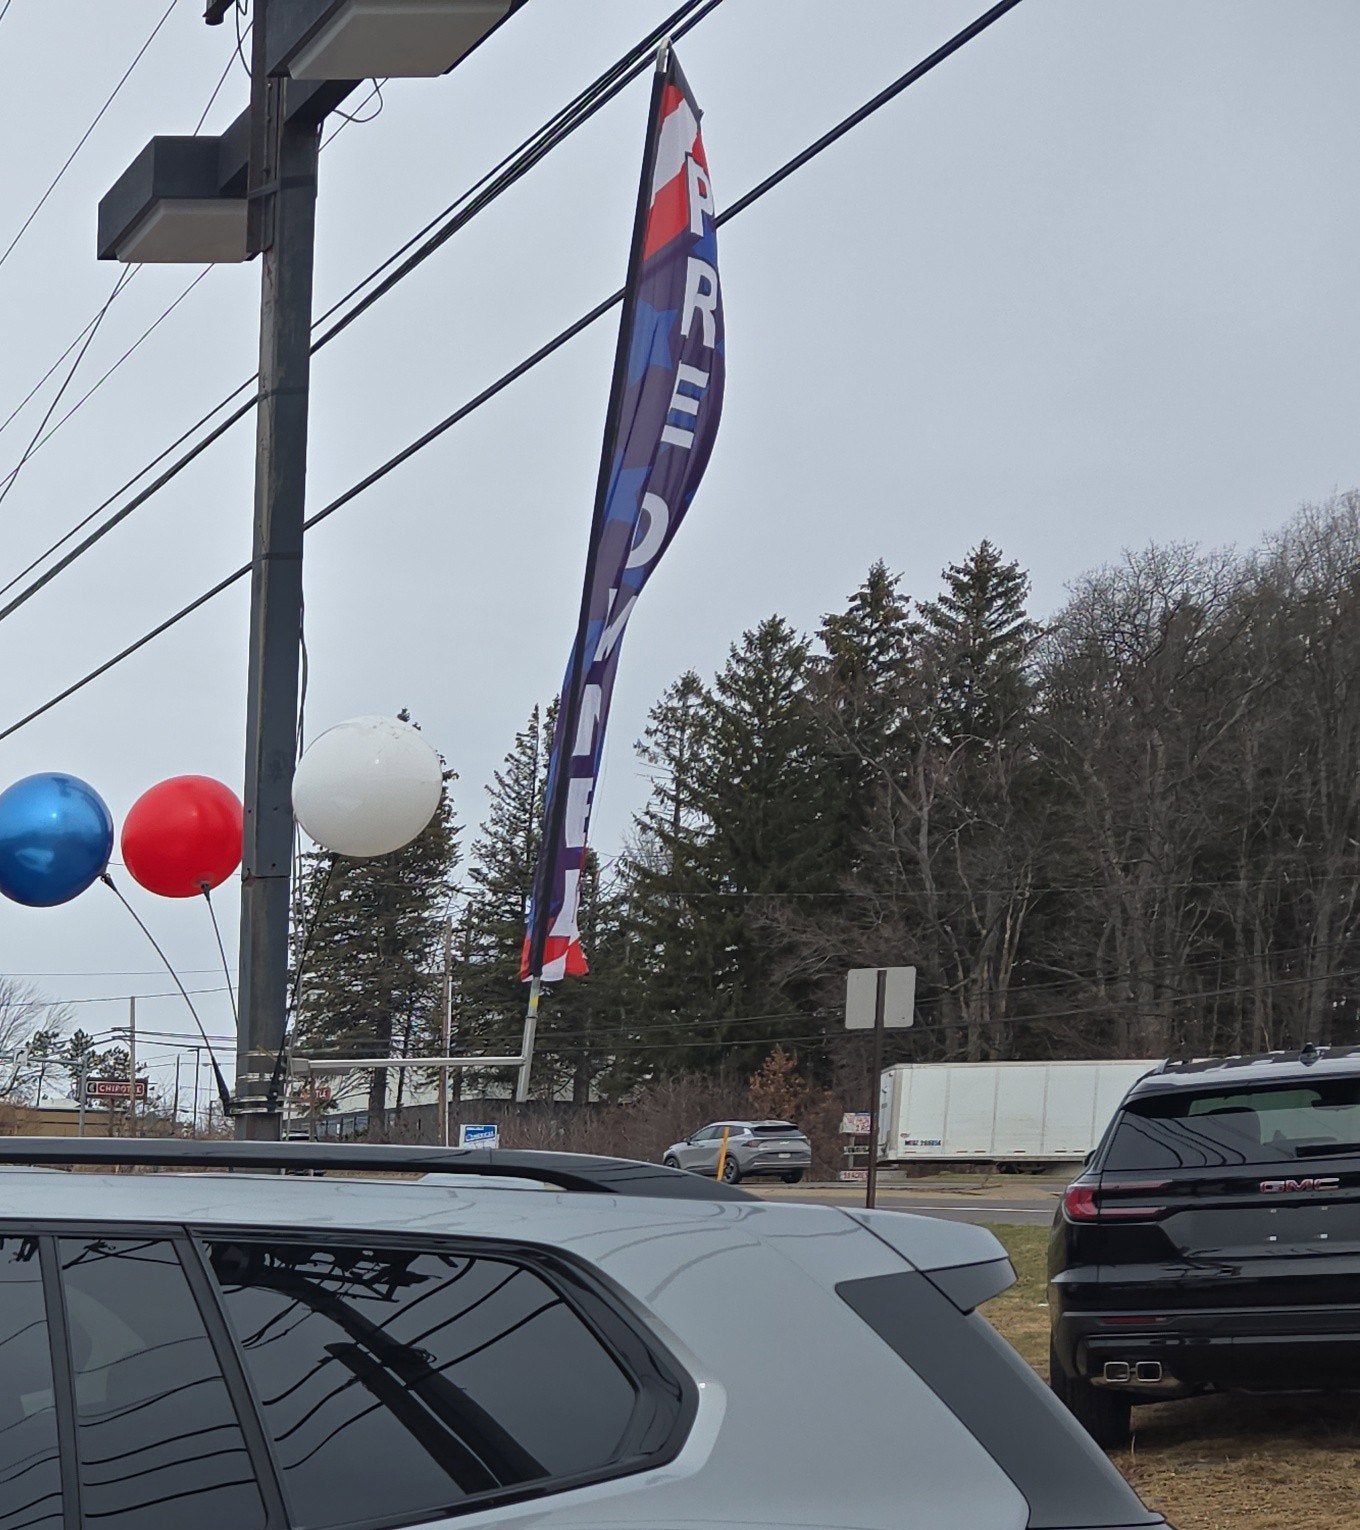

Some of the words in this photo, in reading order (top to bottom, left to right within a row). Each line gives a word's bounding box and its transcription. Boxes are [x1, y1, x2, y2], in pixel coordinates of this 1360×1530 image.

[661, 153, 718, 448] PRE
[99, 1084, 142, 1093] CHIPOTE
[1260, 1177, 1340, 1193] GMC
